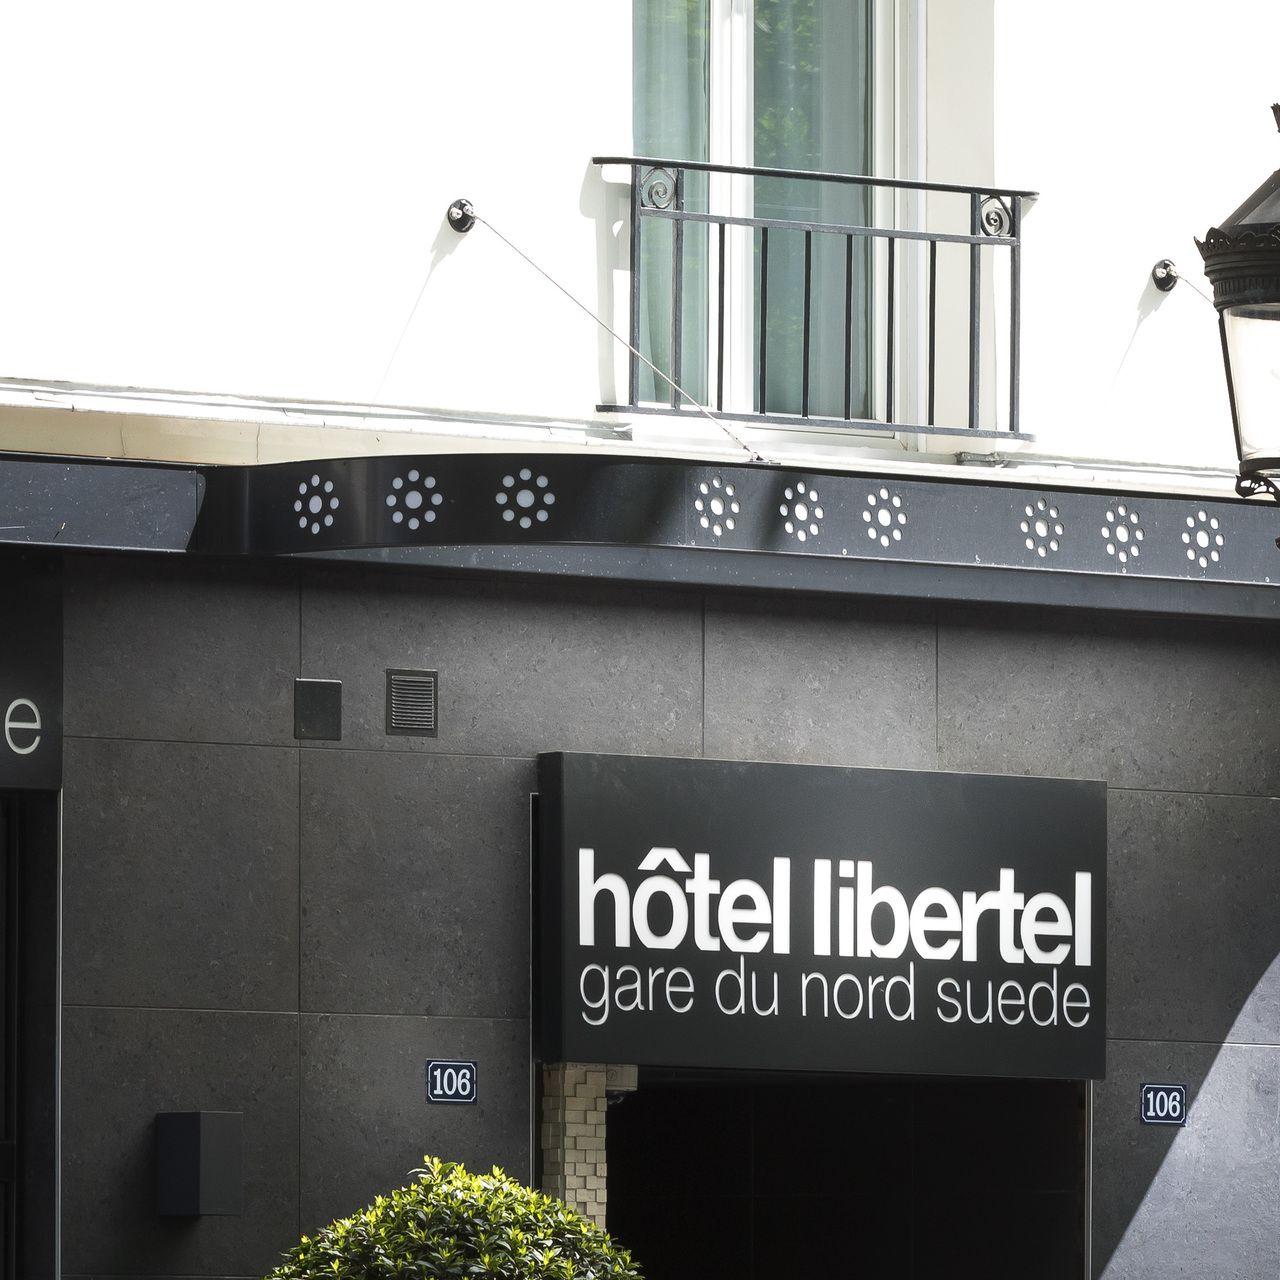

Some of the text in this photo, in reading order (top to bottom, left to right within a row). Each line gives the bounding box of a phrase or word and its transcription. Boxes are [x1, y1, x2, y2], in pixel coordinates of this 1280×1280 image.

[578, 847, 1092, 966] hôtel libertel
[579, 954, 1091, 1028] gare du nord suede
[433, 1068, 471, 1096] 106
[1146, 1090, 1181, 1118] 106
